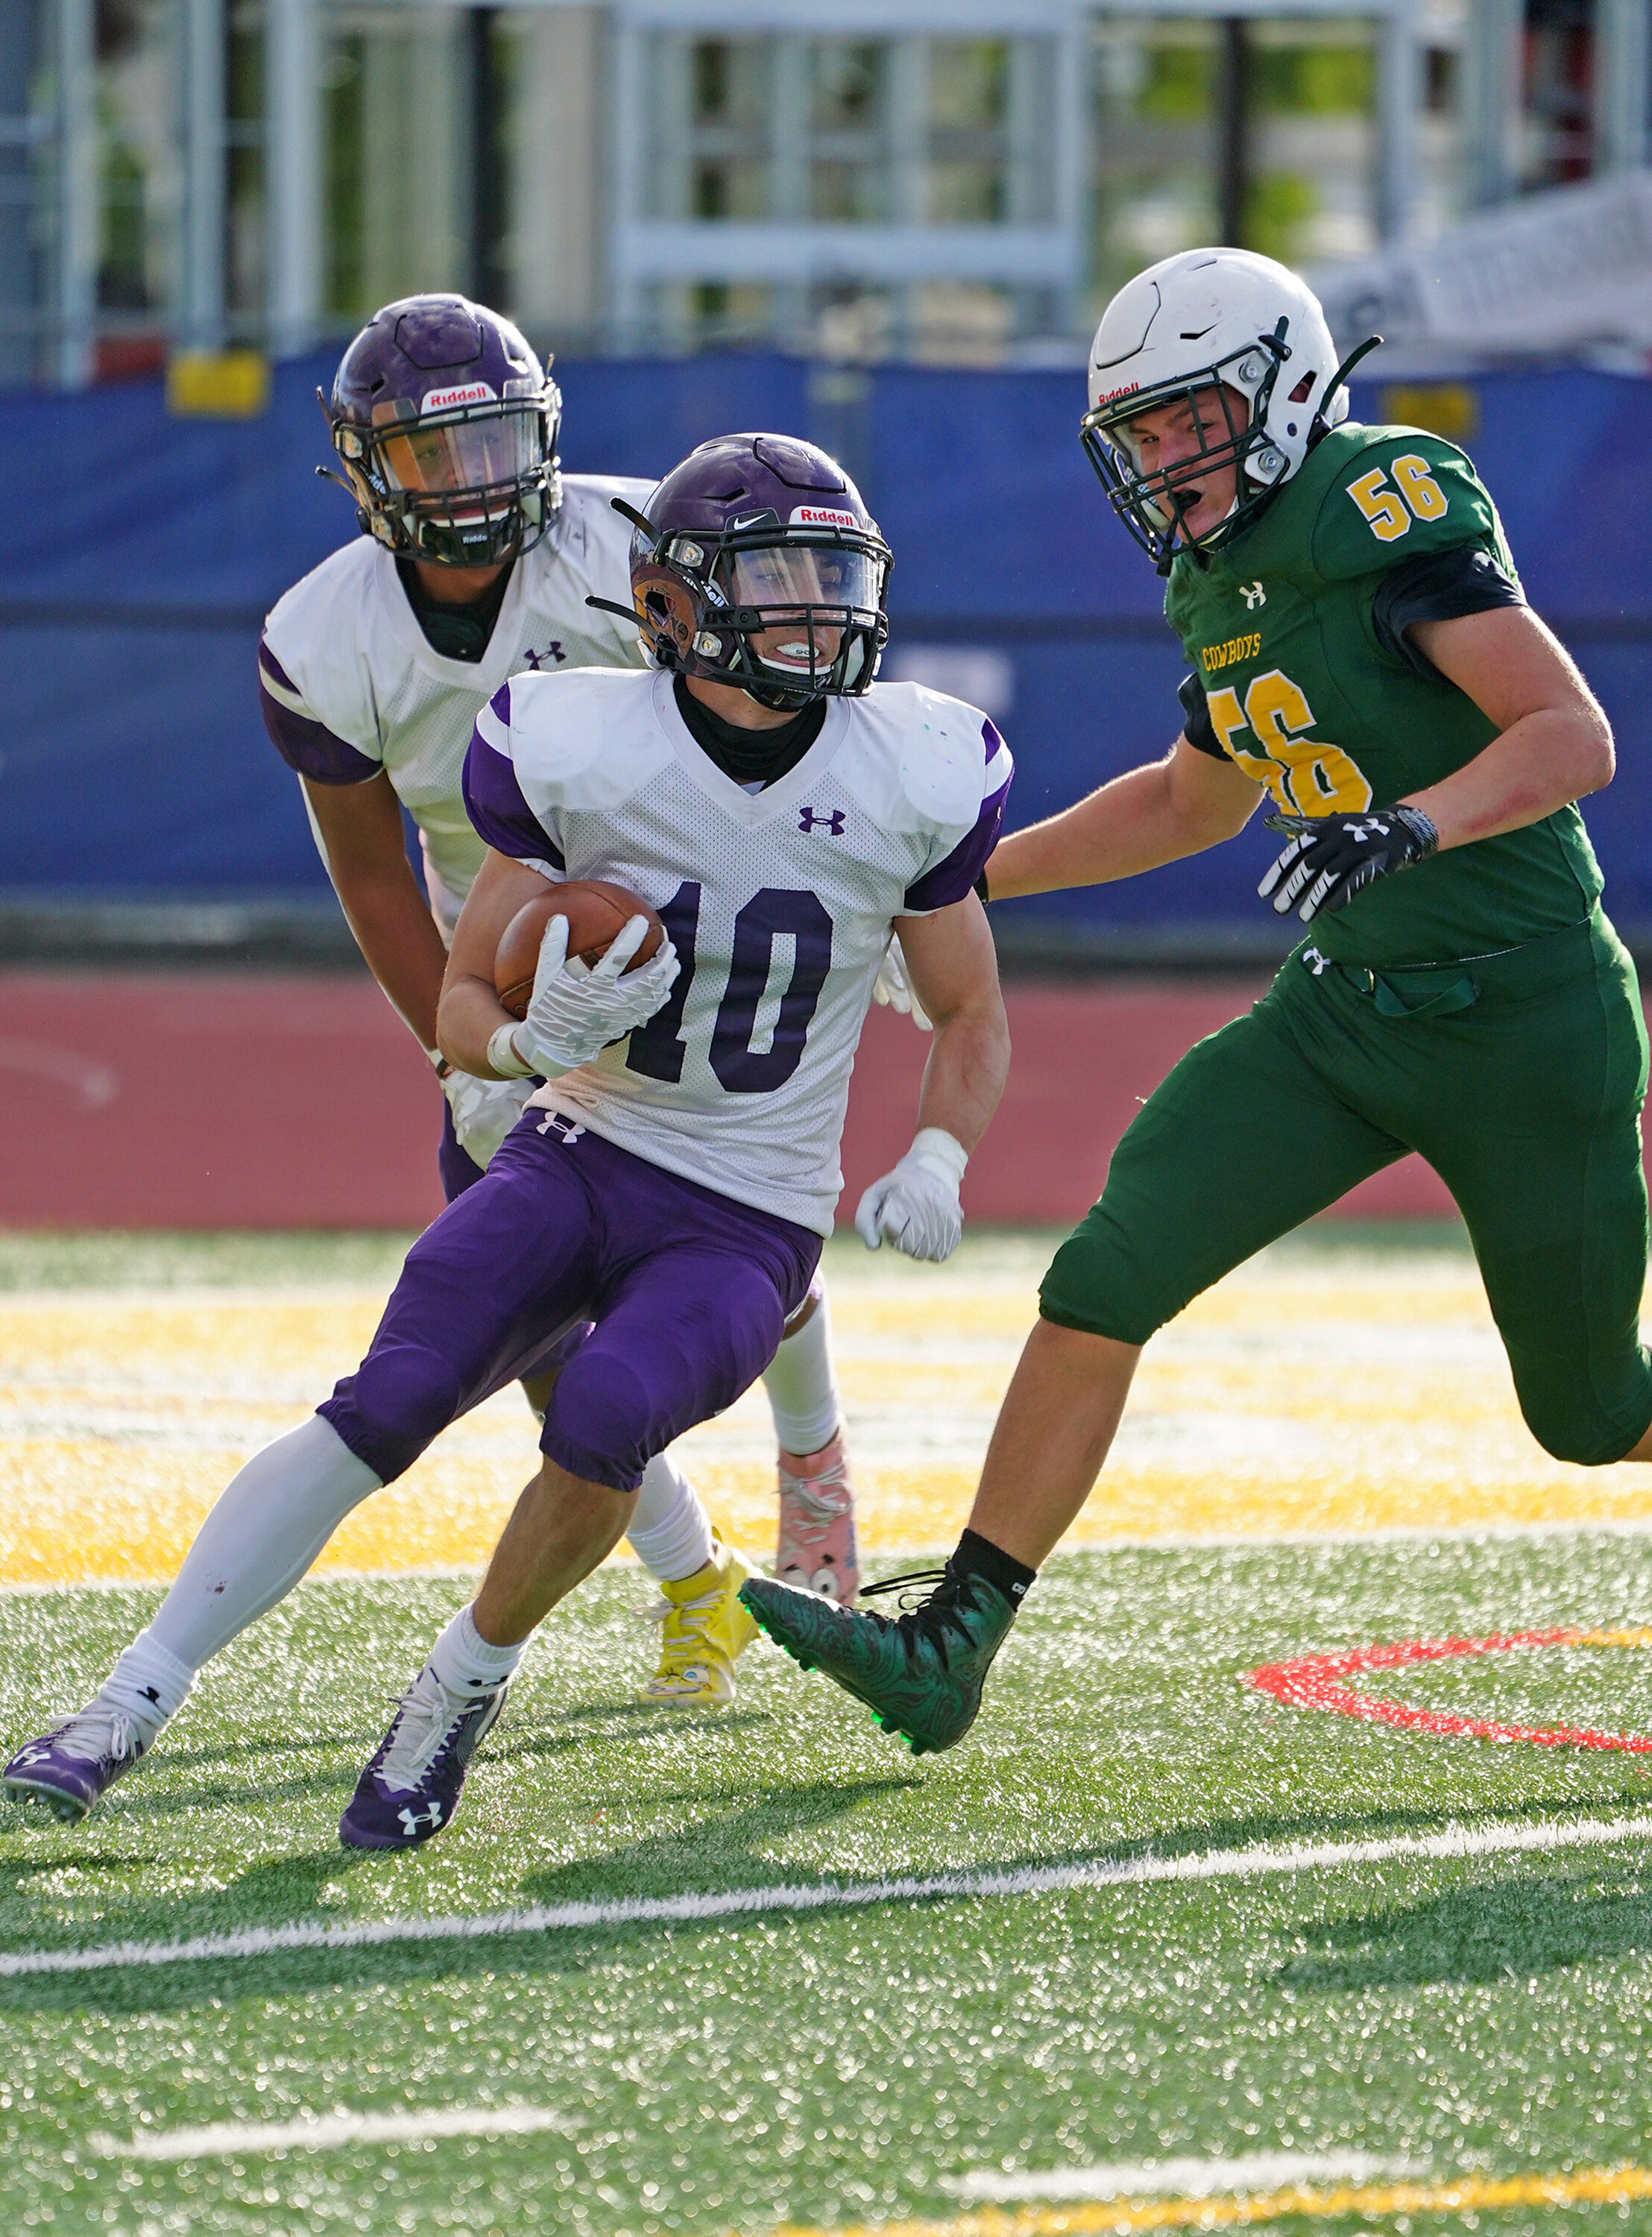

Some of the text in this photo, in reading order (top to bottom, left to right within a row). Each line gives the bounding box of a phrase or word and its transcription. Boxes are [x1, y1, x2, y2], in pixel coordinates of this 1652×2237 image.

[430, 386, 487, 406] Riddell
[1098, 381, 1139, 405] Riddell
[800, 509, 854, 527] Riddell
[1345, 454, 1448, 542] 56
[1202, 632, 1262, 672] COWBOYS
[1206, 668, 1374, 819] 56
[625, 881, 833, 1093] 10
